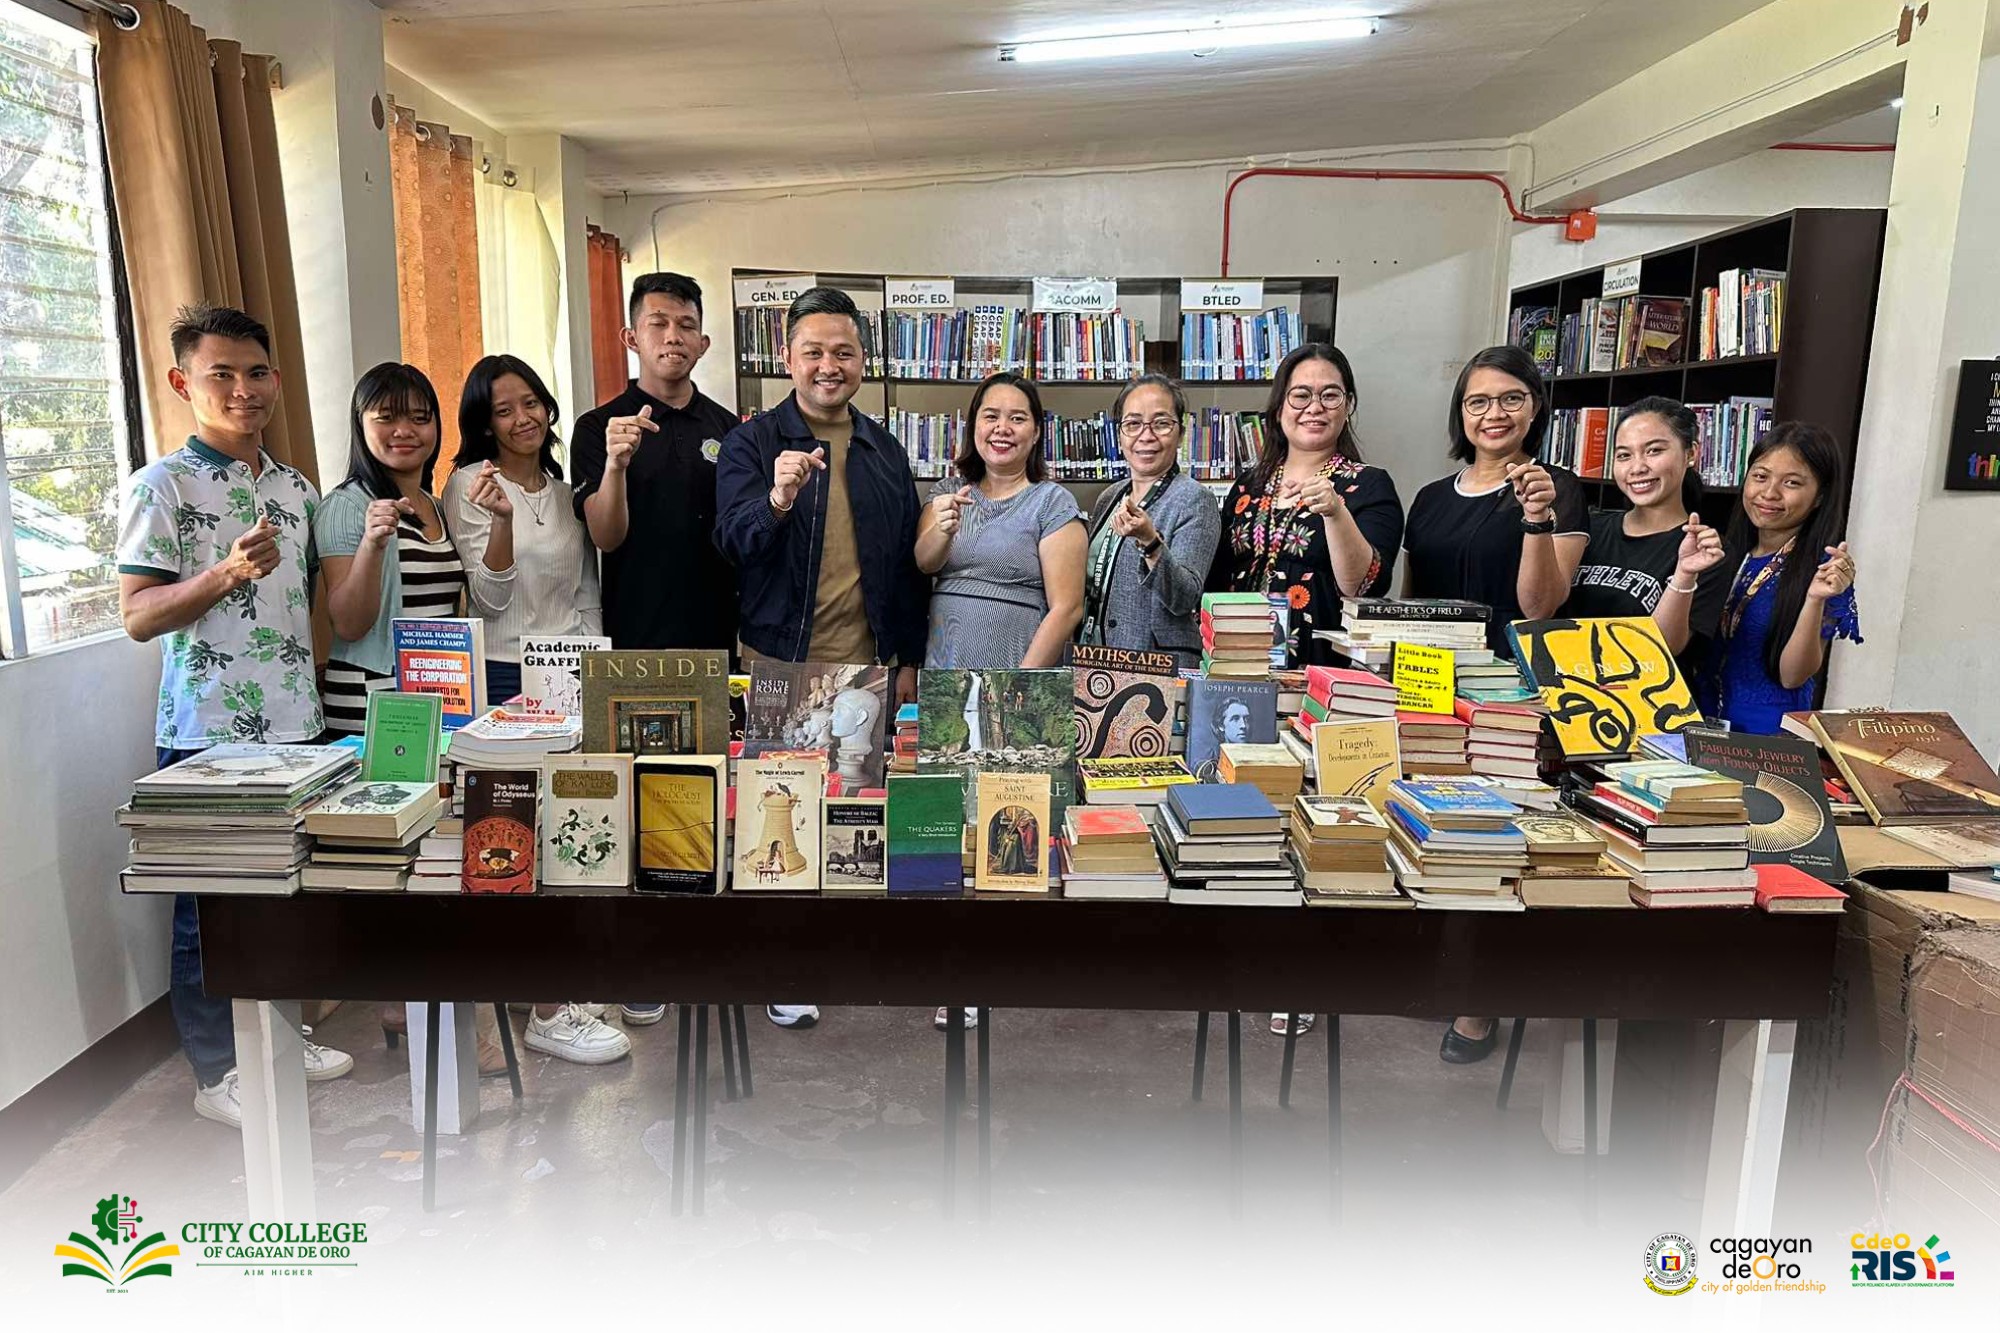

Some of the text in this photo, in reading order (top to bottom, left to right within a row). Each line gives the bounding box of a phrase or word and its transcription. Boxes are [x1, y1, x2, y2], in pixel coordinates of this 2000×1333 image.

[1603, 275, 1639, 292] CIRCULATION
[751, 291, 779, 302] GEN.
[892, 294, 950, 304] PROF. ED.
[1202, 296, 1241, 305] BTLED
[1649, 320, 1680, 331] WORLD
[1571, 565, 1663, 614] THLETE
[1368, 605, 1462, 616] THE AESTHETICS OF FREUD
[434, 632, 464, 640] HAMMER
[1072, 645, 1174, 668] MYTHSCAPES
[1398, 647, 1442, 659] Little Book
[409, 658, 463, 670] REENGINEERING
[524, 655, 580, 667] GRAFFI
[1072, 659, 1111, 668] ABORIGINAL
[586, 657, 722, 679] INSIDE
[1397, 663, 1439, 675] FABLES
[405, 670, 468, 684] THE CORPORATION
[450, 687, 460, 696] FOR
[756, 685, 789, 694] ROME
[1204, 684, 1270, 694] JOSEPH PEARCE
[443, 696, 466, 706] VOLUTION
[526, 697, 542, 709] by
[1847, 718, 1936, 739] Filipino
[1915, 734, 1940, 743] style
[1700, 740, 1806, 763] FABULOUS JEWELRY
[1722, 756, 1760, 771] FOUND
[1763, 761, 1812, 776] OBJECTS
[557, 772, 613, 780] THE WALLET
[555, 779, 567, 787] OF
[667, 783, 685, 791] THE
[652, 789, 701, 799] HOLOCAUST
[1004, 785, 1026, 794] SAINT
[994, 793, 1034, 801] AUGUSTINE
